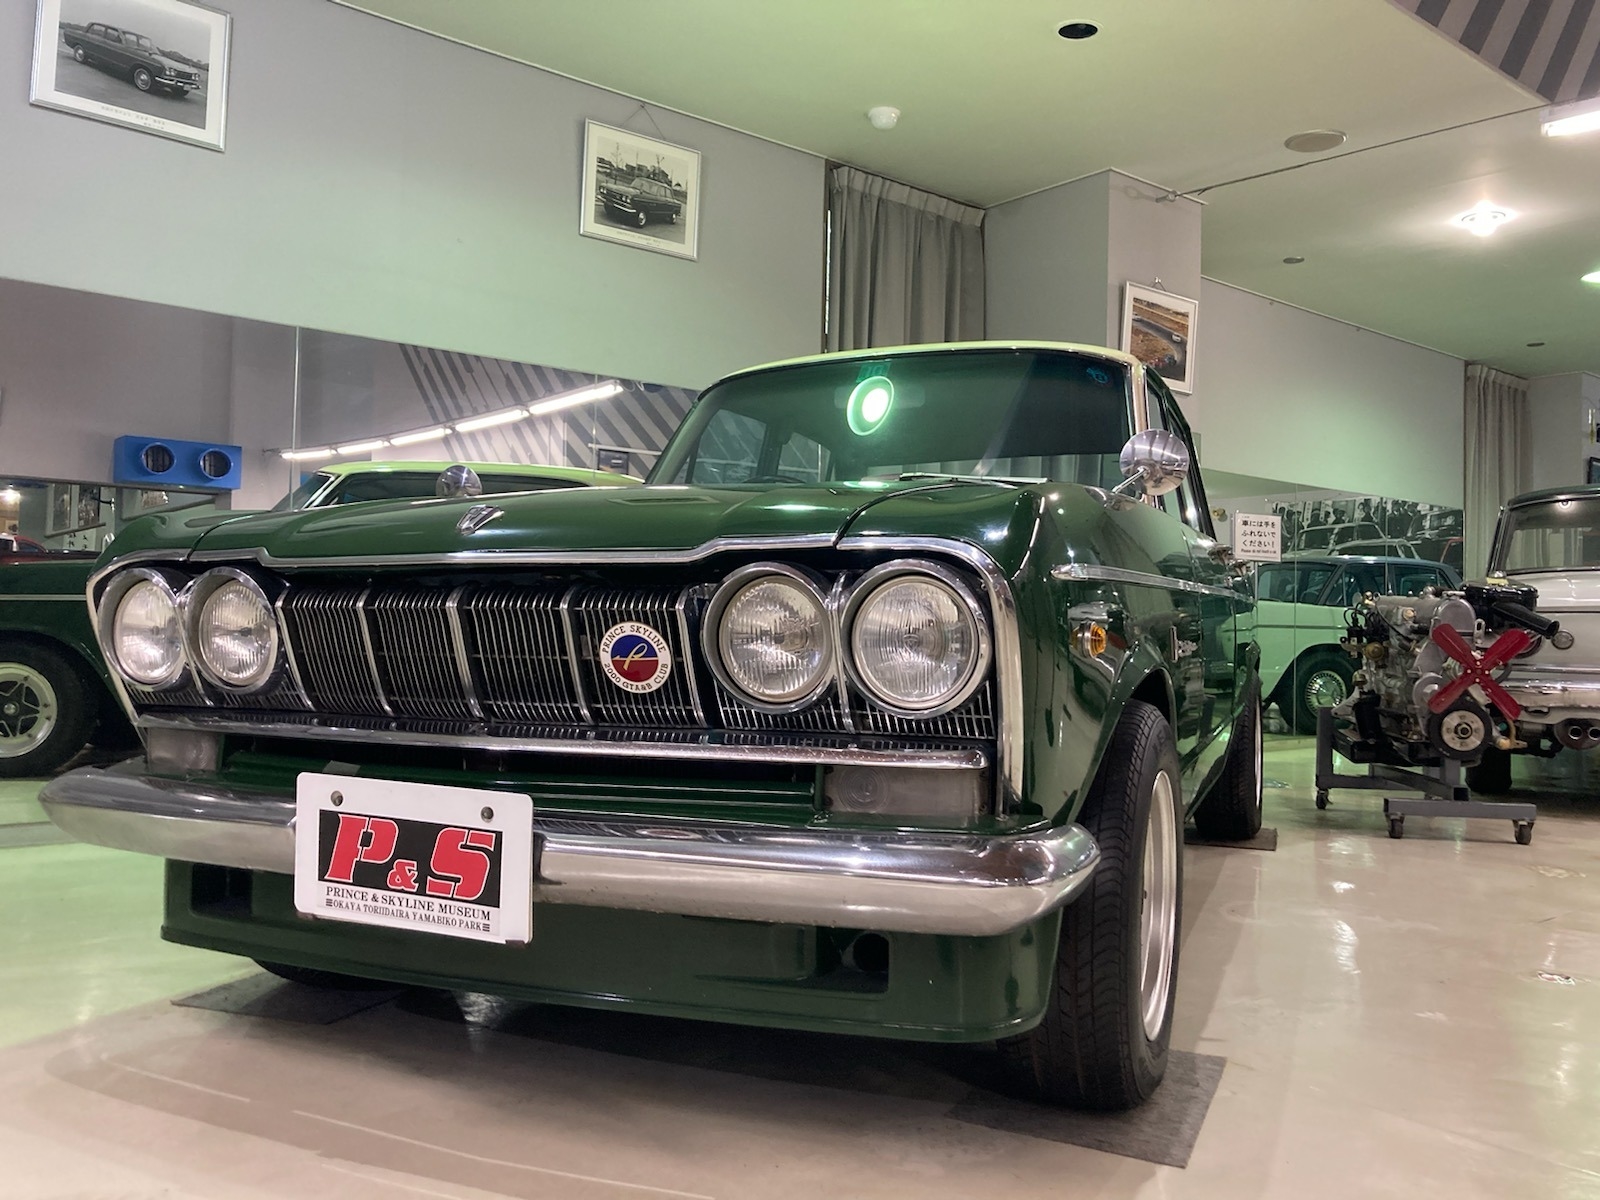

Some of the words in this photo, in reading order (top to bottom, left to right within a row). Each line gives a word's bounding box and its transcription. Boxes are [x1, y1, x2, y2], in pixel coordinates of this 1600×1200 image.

[1241, 530, 1276, 538] ふれないで
[602, 625, 626, 653] PRINCE
[630, 624, 666, 653] SKYLINE
[604, 663, 621, 683] 2000
[653, 663, 669, 684] CLUB
[326, 886, 368, 901] PRINCE
[371, 892, 379, 903] &
[381, 894, 434, 912] SKYLINE
[438, 903, 490, 921] MUSEUM
[333, 900, 361, 912] OKAYA
[363, 904, 410, 919] TORIIDAIRA
[412, 911, 457, 927] YAMABIKO
[459, 920, 482, 931] PARK
